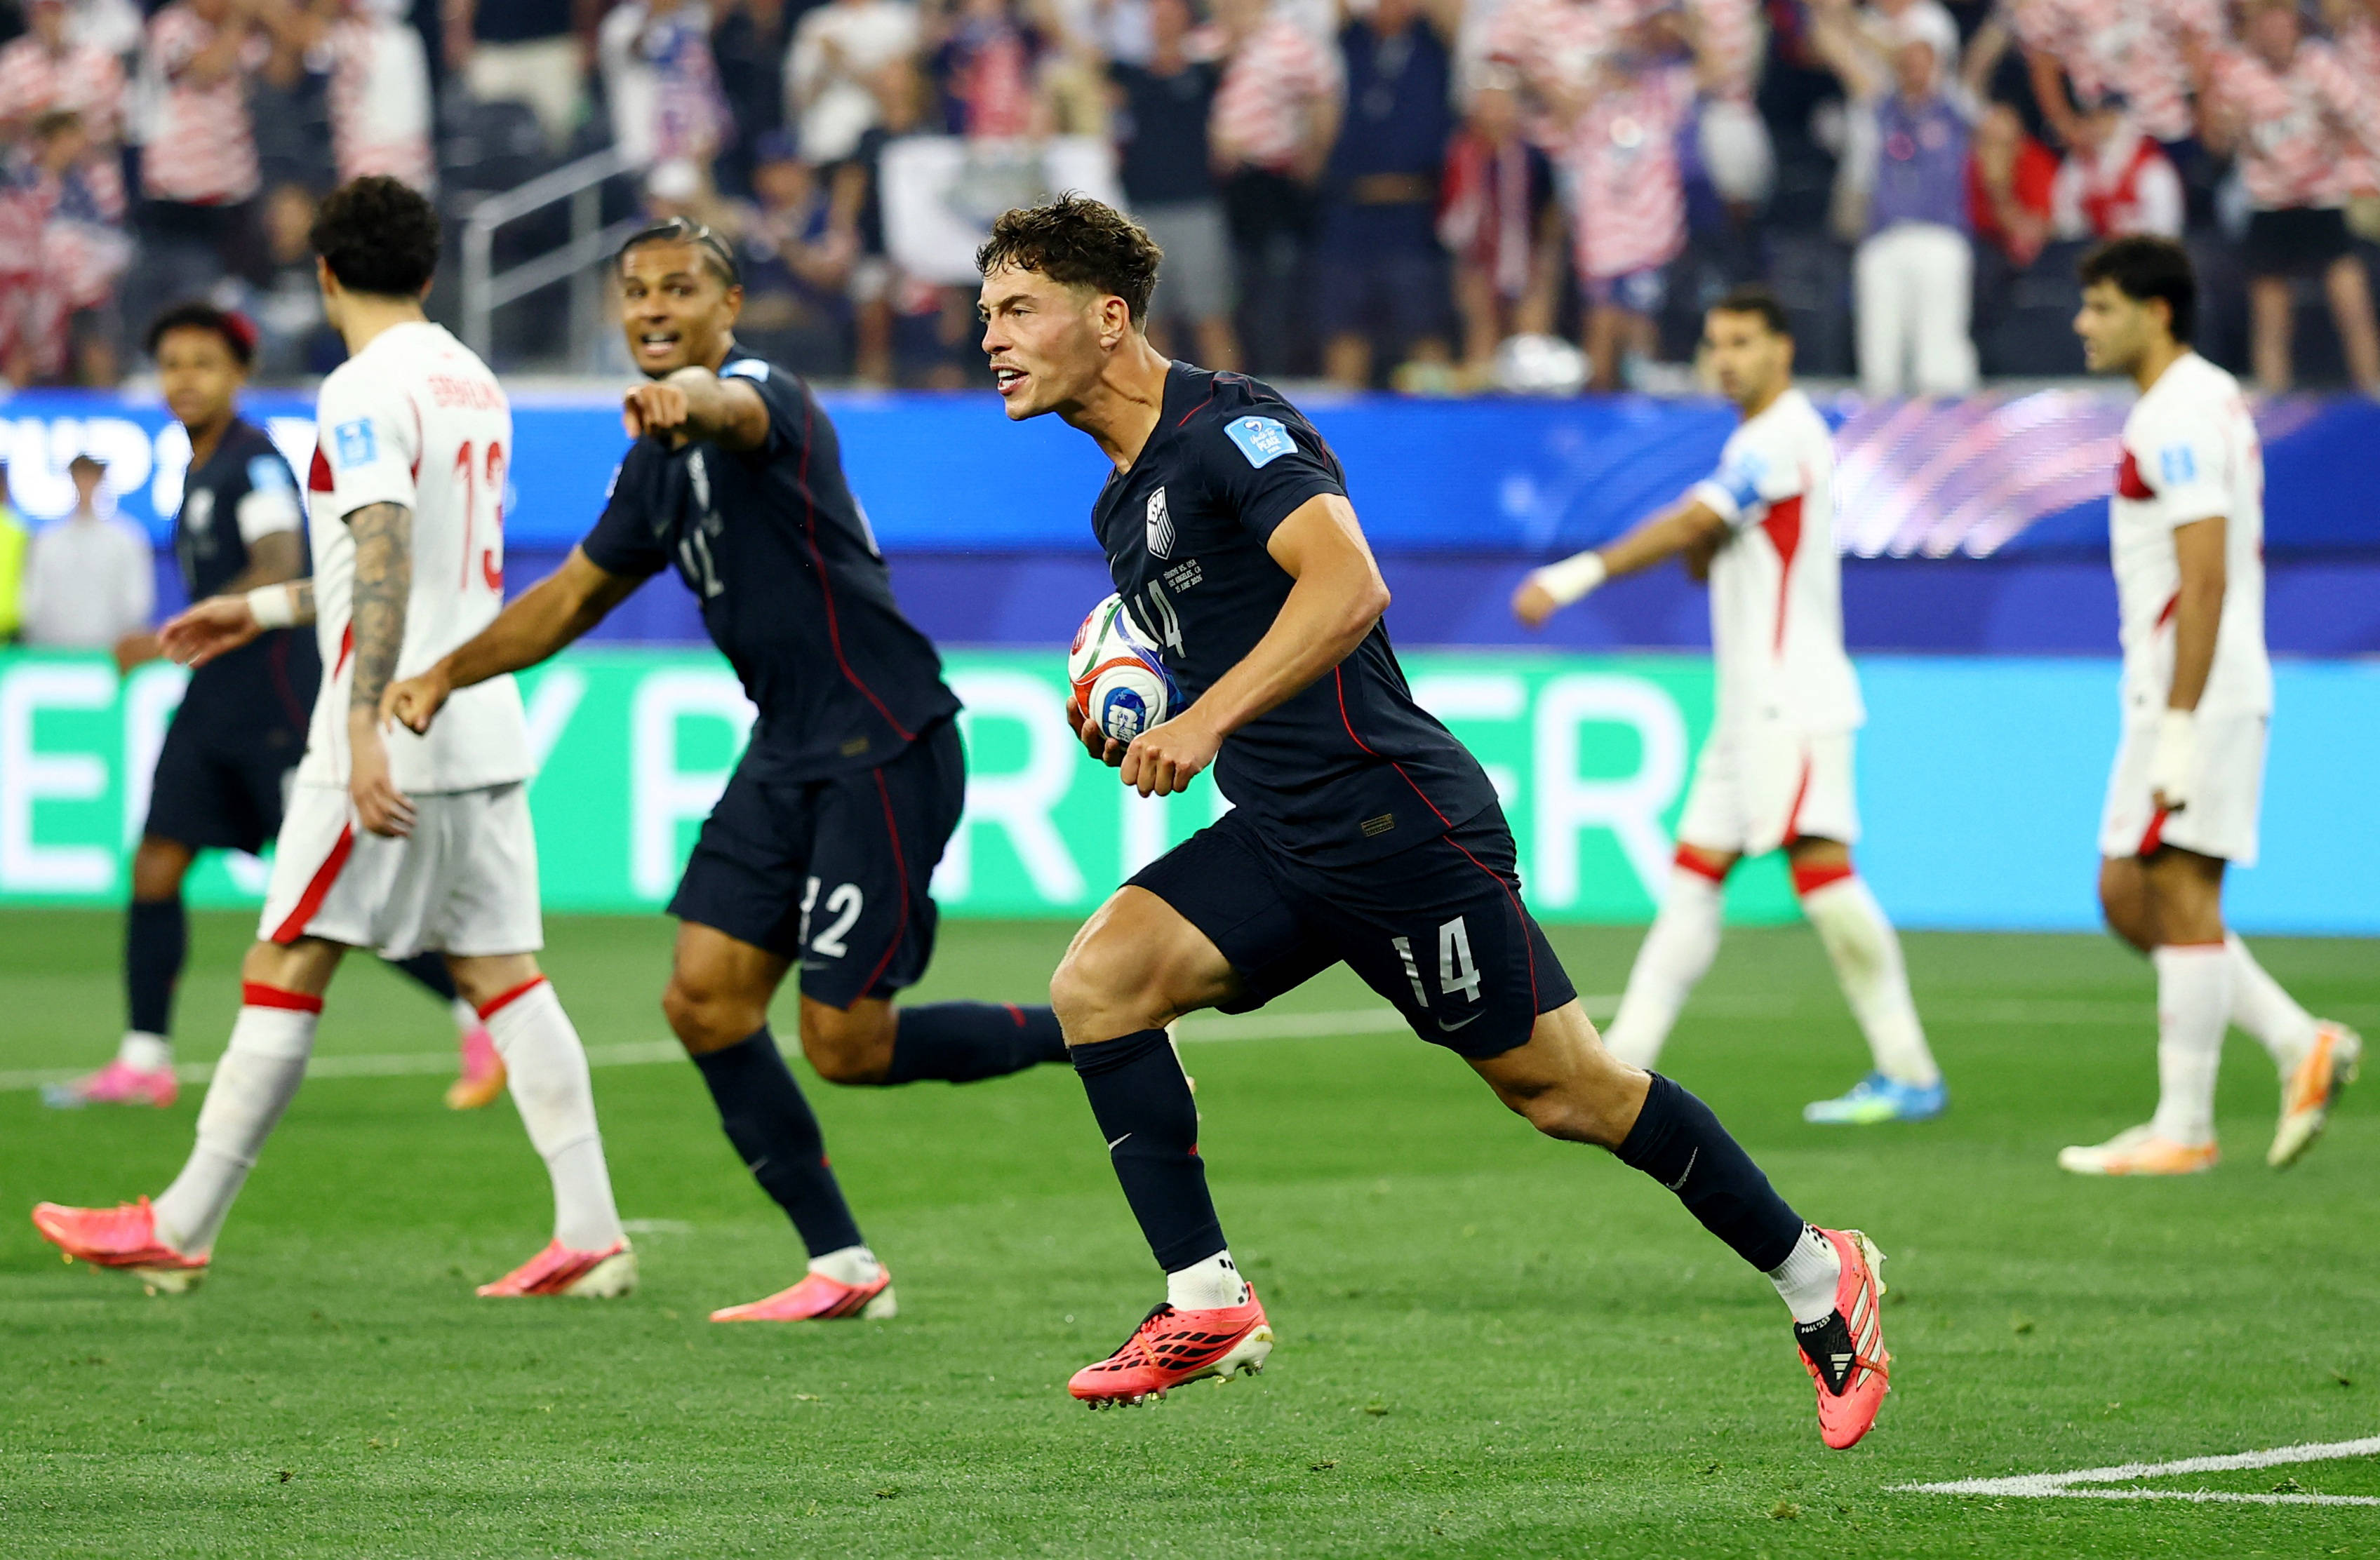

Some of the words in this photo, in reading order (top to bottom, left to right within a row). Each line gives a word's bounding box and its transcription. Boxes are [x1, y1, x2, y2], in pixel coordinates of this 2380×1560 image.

[1186, 558, 1197, 568] USA
[1194, 565, 1202, 574] CA
[1134, 579, 1186, 659] 14
[1391, 915, 1481, 1008] 14
